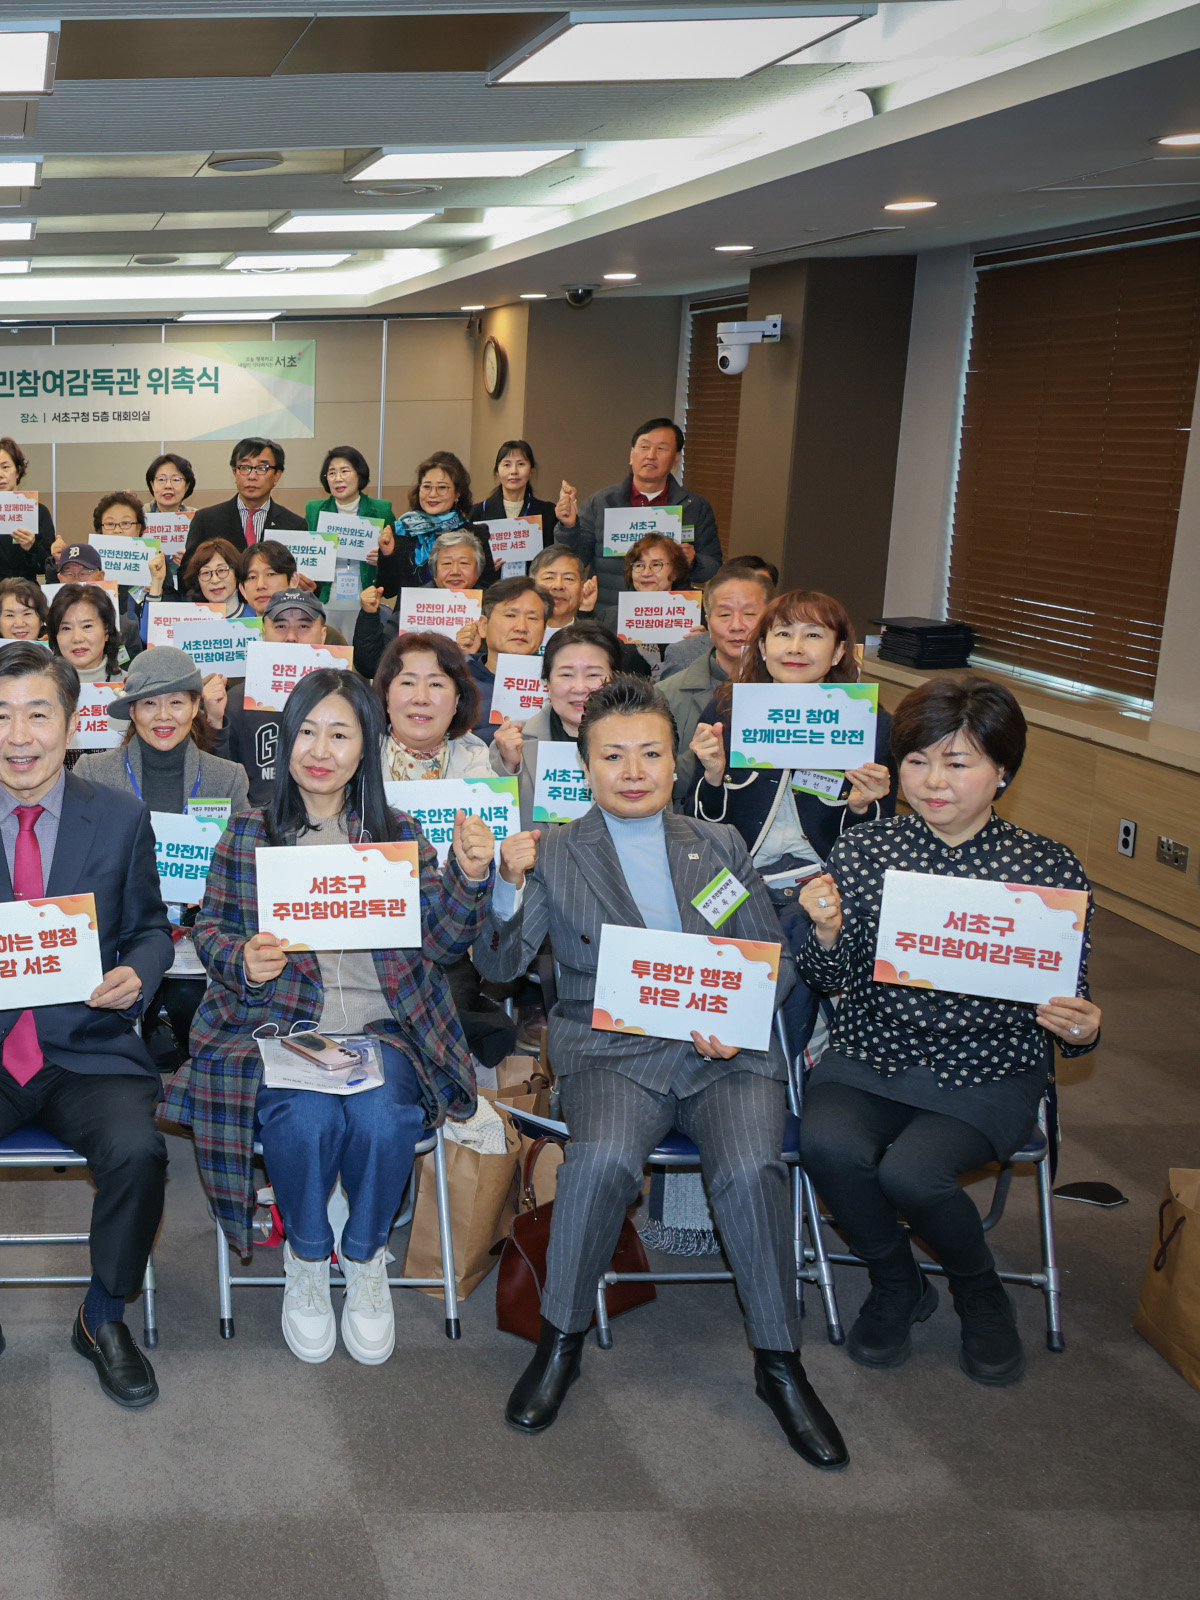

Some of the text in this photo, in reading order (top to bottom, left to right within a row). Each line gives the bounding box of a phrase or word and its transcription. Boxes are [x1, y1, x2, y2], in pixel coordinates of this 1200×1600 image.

[275, 355, 298, 368] 서초
[146, 366, 220, 396] 위촉식
[20, 410, 150, 423] 장소 서초구청 5층 대회의실
[4, 503, 35, 512] 함께하는
[7, 513, 23, 522] 서초
[173, 523, 191, 533] 깨끗
[326, 525, 373, 539] 안전친화도시
[628, 521, 657, 531] 서초구
[169, 534, 185, 543] 서초
[513, 529, 530, 539] 행정
[348, 538, 365, 548] 서초
[491, 540, 526, 551] 맑은 서초
[98, 549, 149, 562] 안전친화도시
[104, 560, 140, 572] 안심 서초
[299, 558, 318, 567] 서초
[415, 602, 467, 615] 안전의 시작
[634, 606, 686, 617] 안전의 시작
[625, 617, 694, 630] 주민참여감독관
[181, 638, 233, 651] 서초안전의
[272, 663, 297, 678] 안전
[503, 677, 541, 692] 주민과
[519, 695, 544, 709] 행복
[767, 708, 840, 725] 주민 참여
[84, 720, 109, 732] 서초
[741, 728, 865, 745] 함께만드는 안전
[542, 768, 585, 784] 서초구
[479, 806, 509, 823] 시작
[308, 874, 368, 895] 서초구
[272, 897, 408, 922] 주민참여감독관
[942, 910, 1016, 938] 서초구
[37, 926, 78, 950] 행정
[894, 930, 1064, 972] 주민참여감독관
[22, 954, 62, 976] 서초
[630, 958, 743, 991] 투명한 행정
[639, 985, 729, 1014] 맑은 서초
